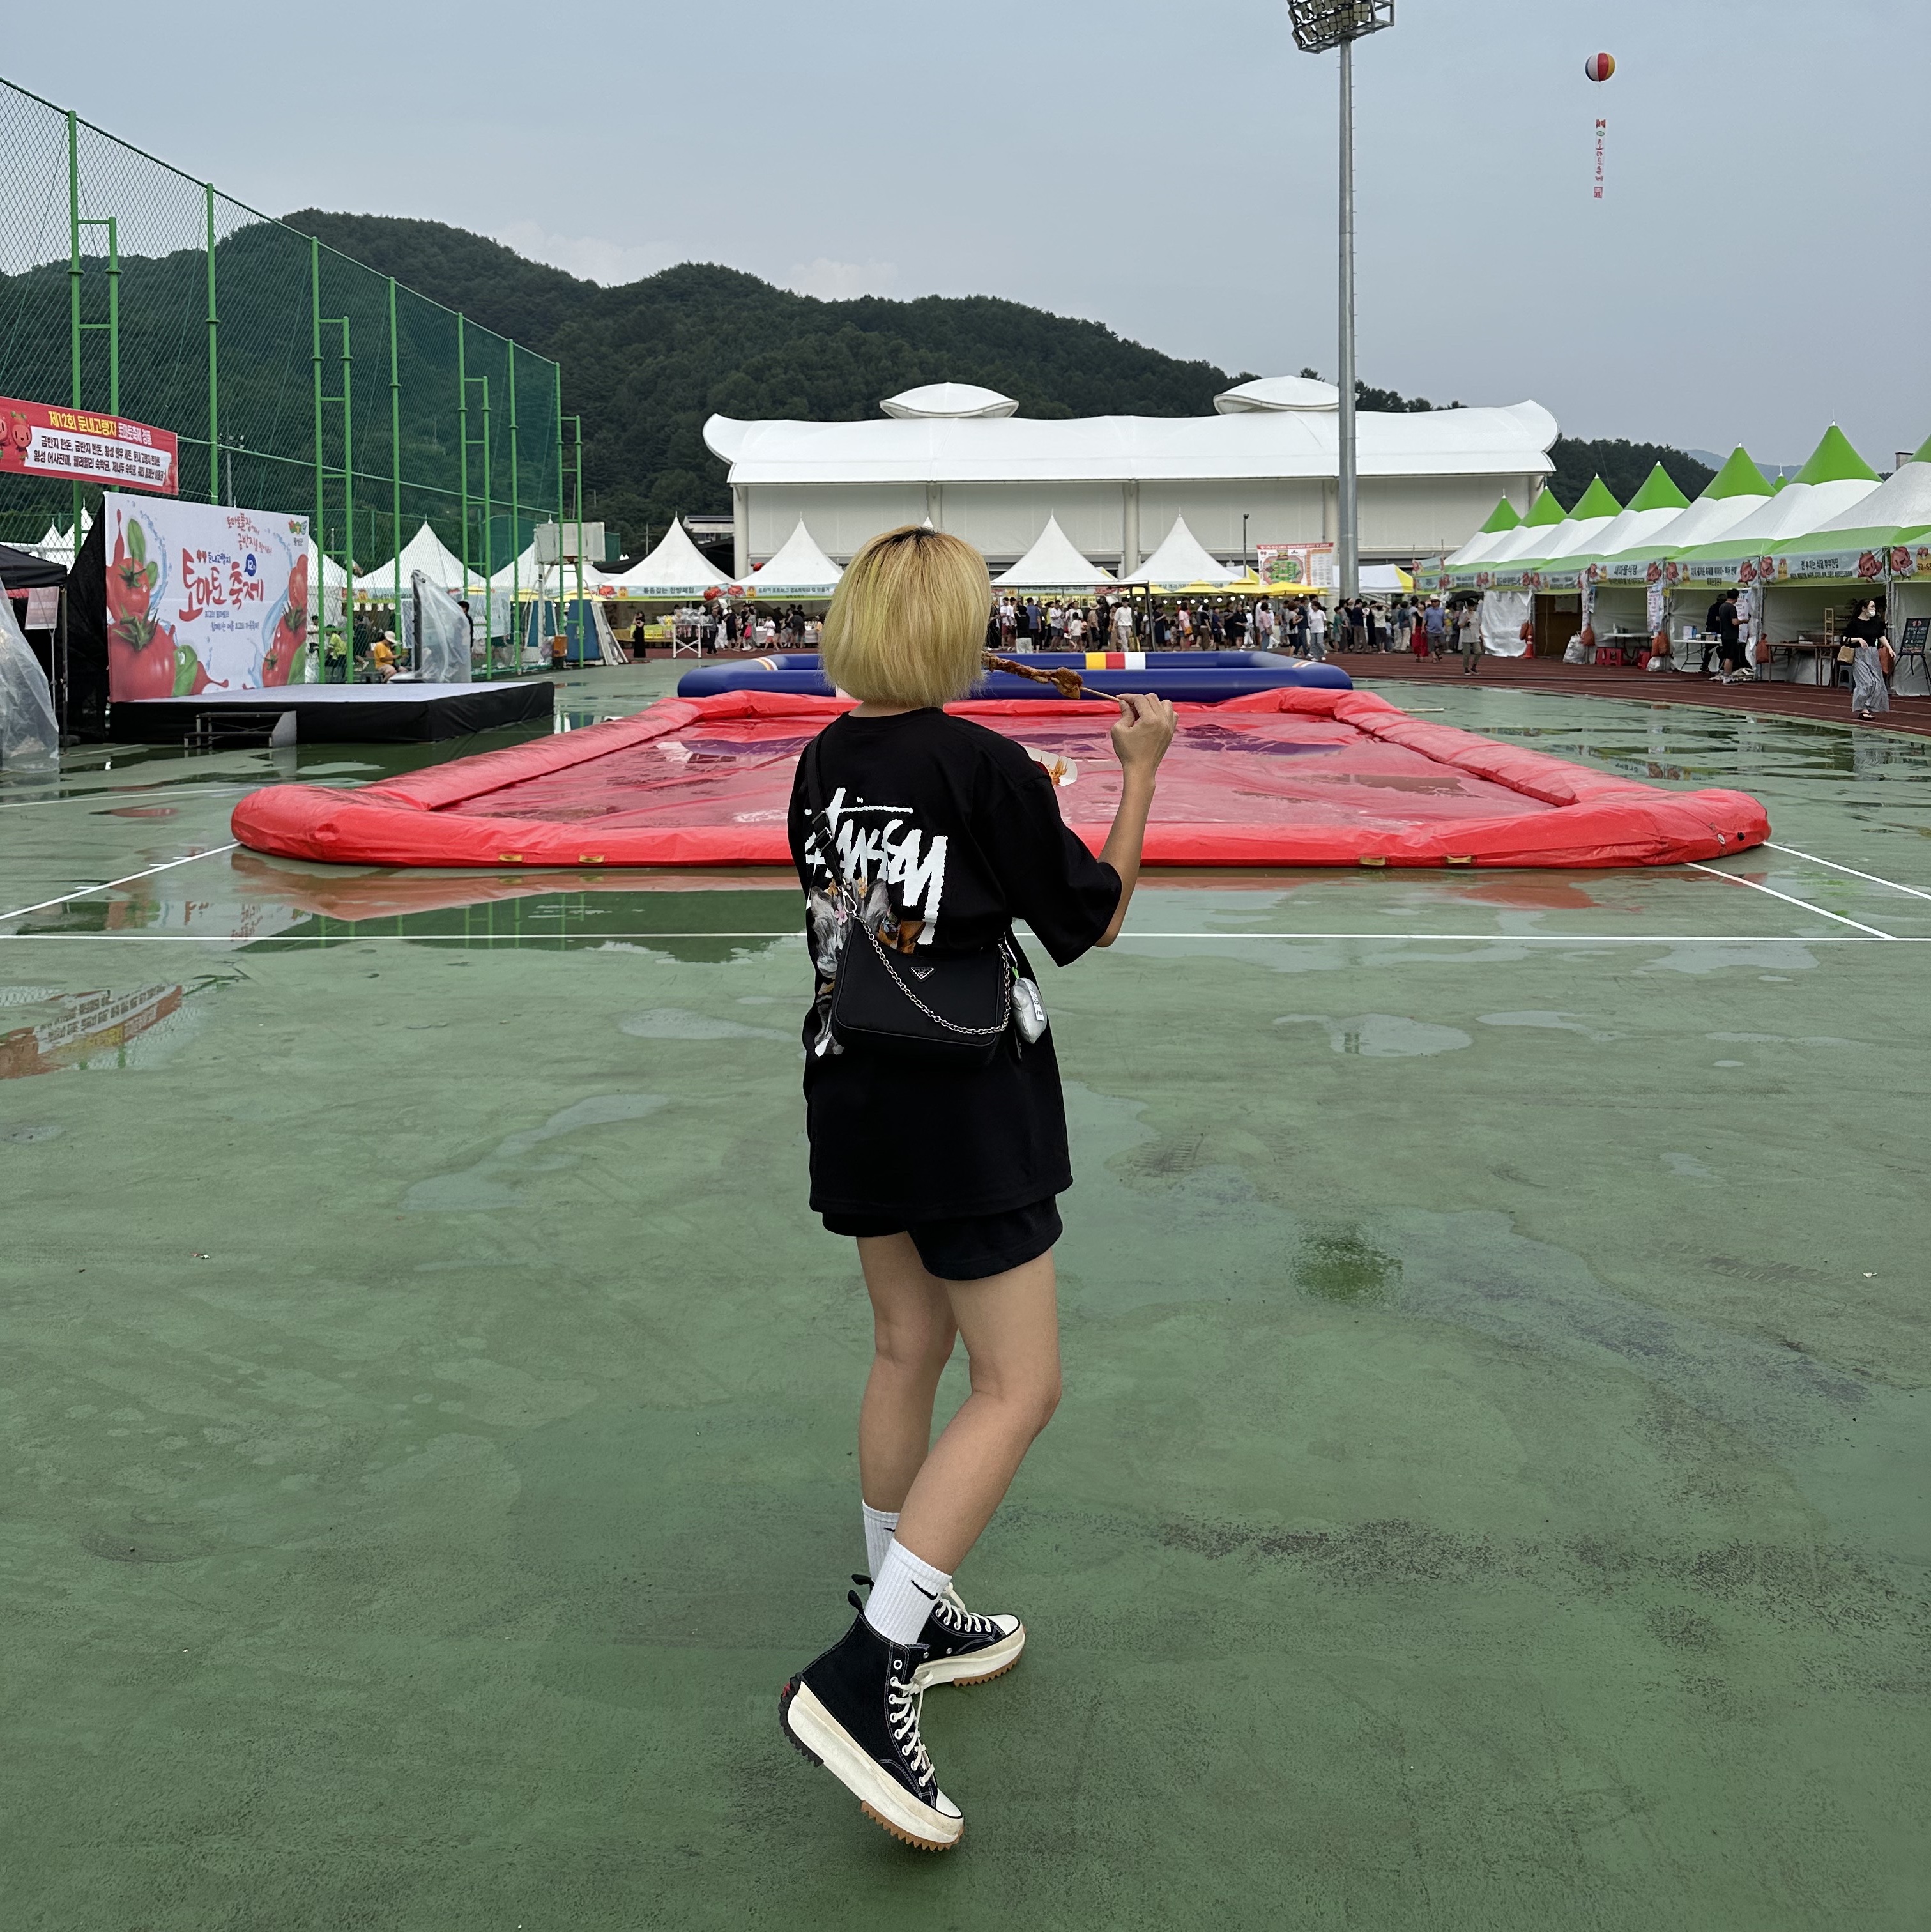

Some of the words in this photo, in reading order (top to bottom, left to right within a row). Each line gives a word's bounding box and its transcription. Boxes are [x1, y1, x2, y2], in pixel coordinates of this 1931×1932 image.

[48, 411, 77, 431] 제12회
[77, 415, 117, 437] 둔내고랭지
[41, 435, 59, 450] 금반지
[60, 438, 73, 451] 한돈,
[75, 440, 91, 454] 금반지
[91, 443, 103, 456] 반돈,
[34, 450, 45, 463] 횡성
[208, 551, 231, 565] 둔내고랭지
[179, 548, 227, 622] 토마토
[229, 561, 264, 611] 축제
